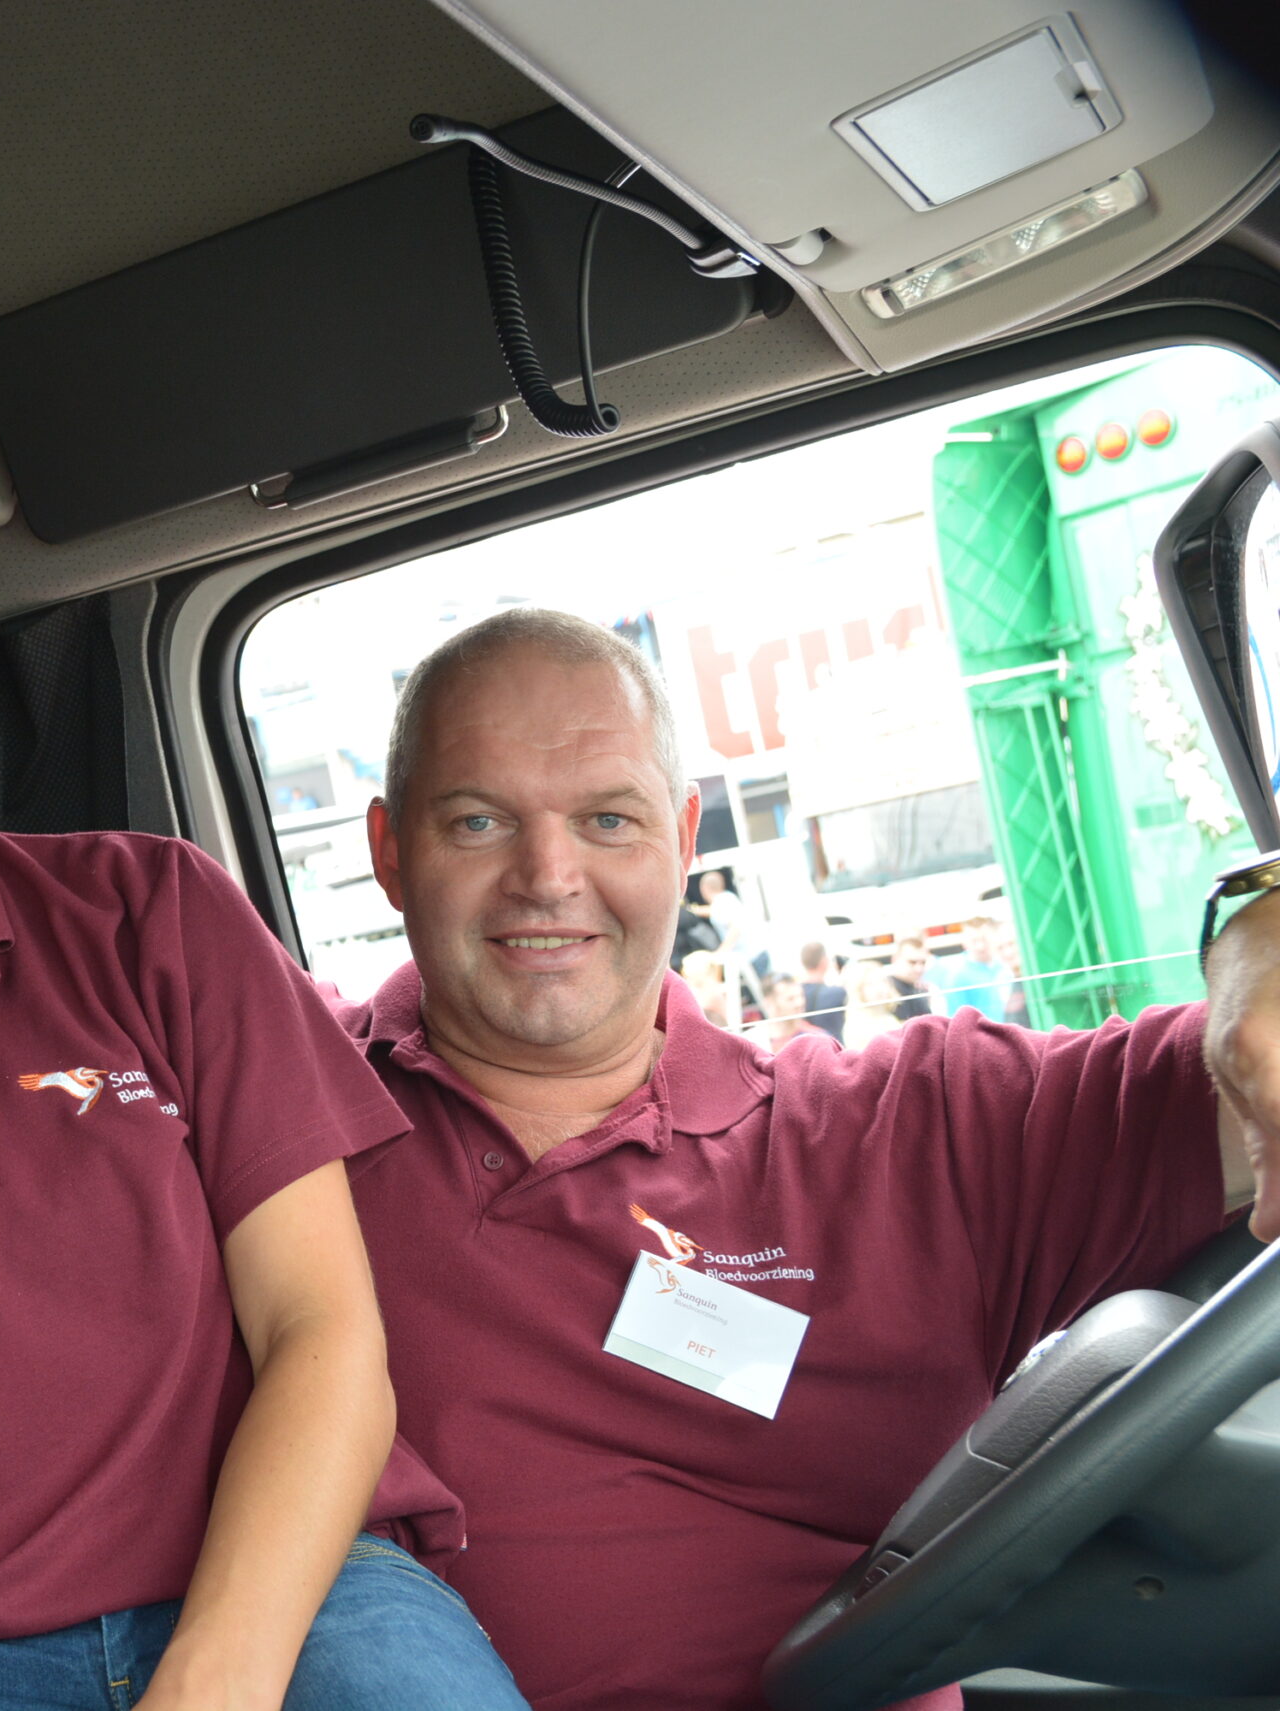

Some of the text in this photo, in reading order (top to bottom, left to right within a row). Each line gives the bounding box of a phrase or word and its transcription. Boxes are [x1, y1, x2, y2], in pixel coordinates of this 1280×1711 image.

[703, 1246, 787, 1268] Sanquin
[705, 1265, 816, 1282] Bloedvoorziening
[676, 1287, 719, 1312] Sanquin
[686, 1340, 717, 1360] PIET
